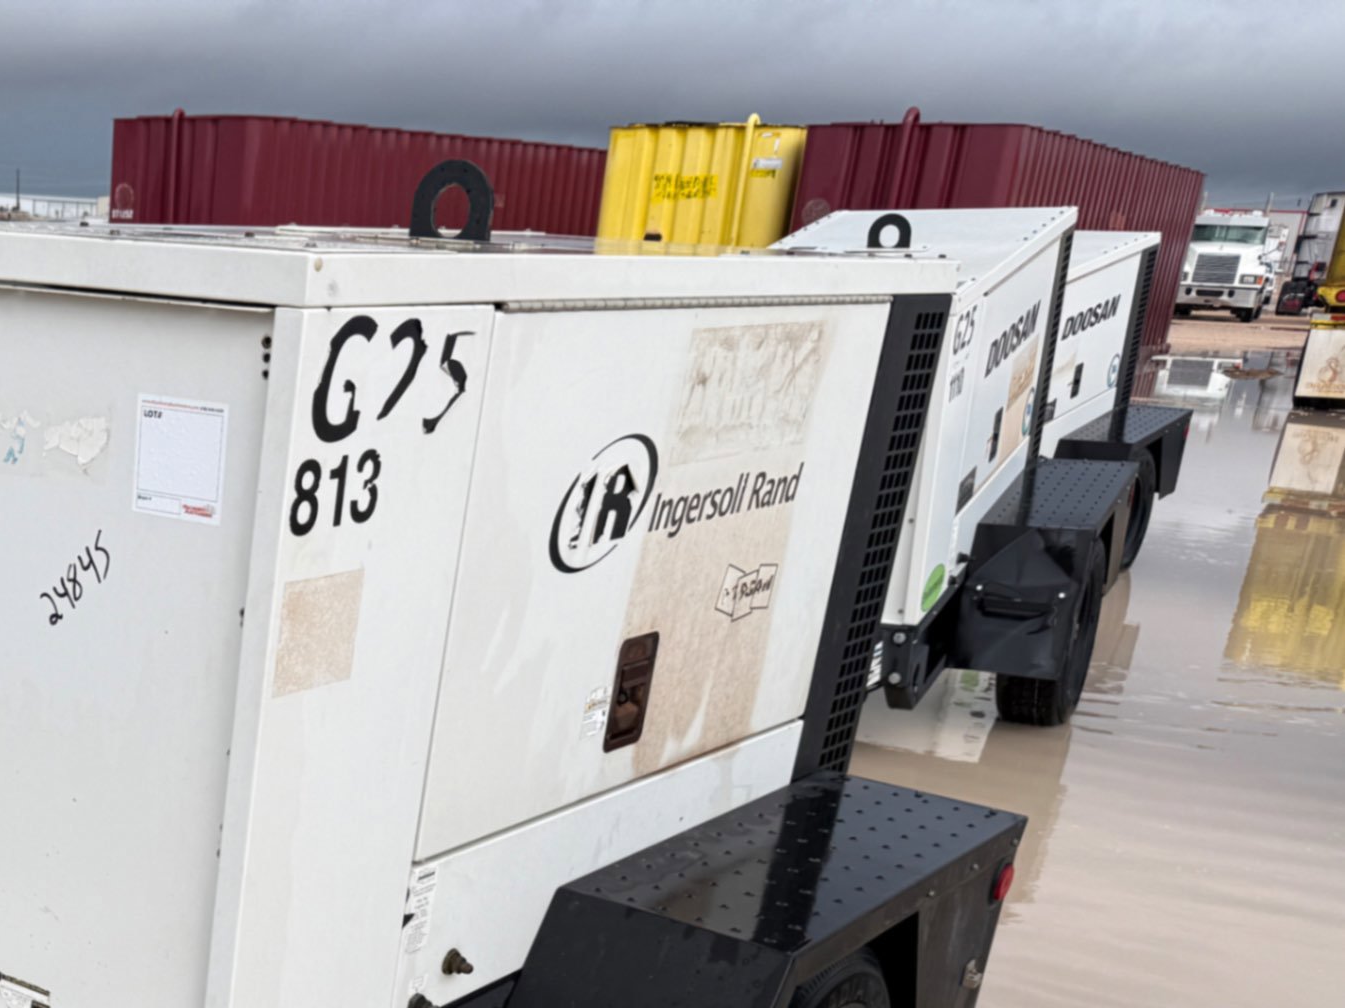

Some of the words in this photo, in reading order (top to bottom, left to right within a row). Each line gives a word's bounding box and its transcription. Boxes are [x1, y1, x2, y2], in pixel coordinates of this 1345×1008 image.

[984, 299, 1041, 378] DOOSAN
[1061, 294, 1121, 340] DOOSAN
[289, 448, 382, 537] 813
[647, 472, 750, 538] Ingersoll
[747, 461, 805, 512] Rand
[40, 528, 110, 626] 24845
